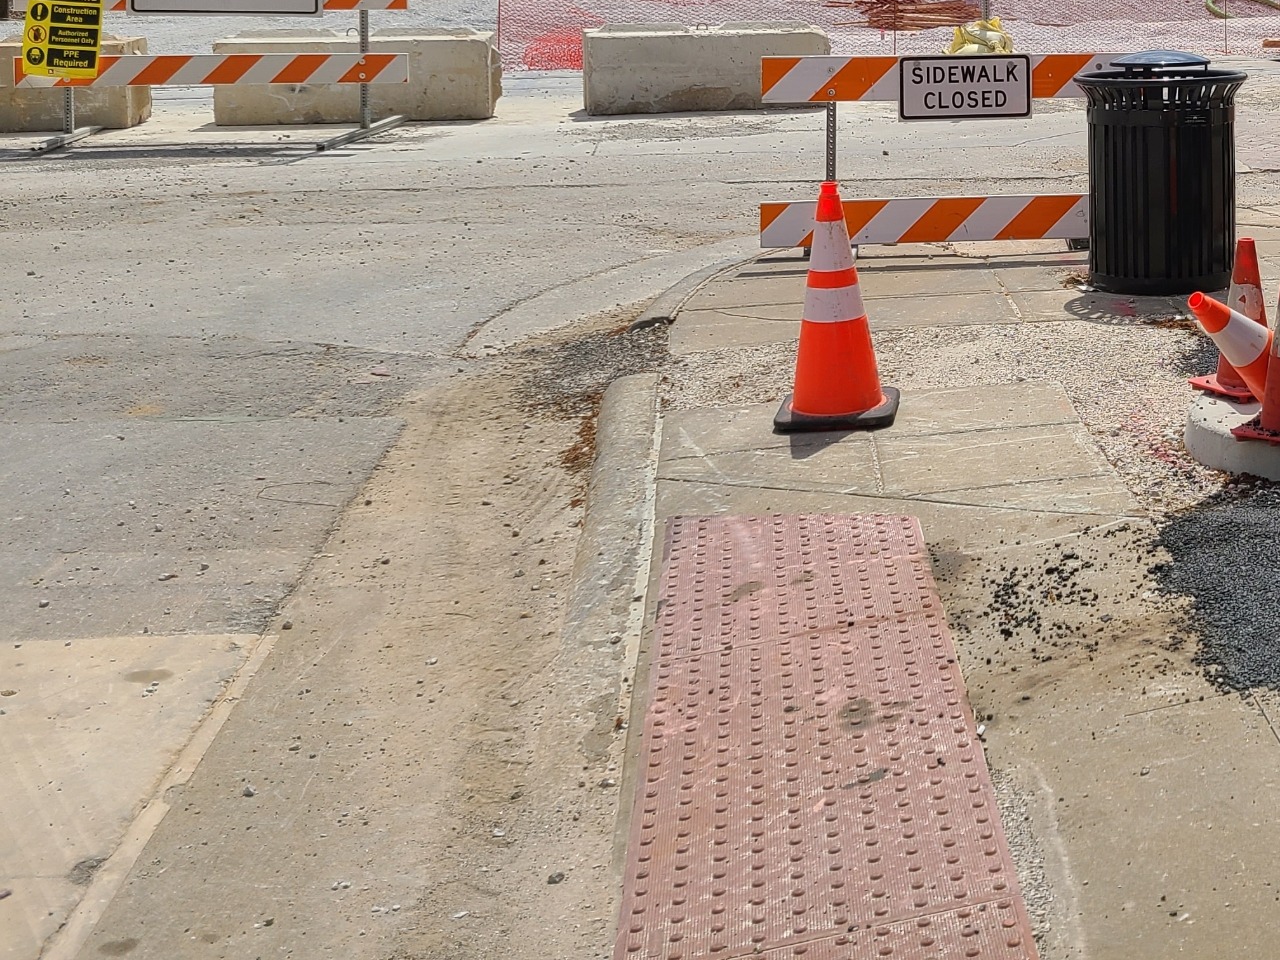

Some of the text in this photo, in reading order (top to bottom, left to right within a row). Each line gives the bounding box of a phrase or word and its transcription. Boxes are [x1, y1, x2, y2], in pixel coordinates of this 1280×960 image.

[53, 5, 97, 15] Construction
[65, 15, 83, 23] Area
[58, 29, 89, 37] Authorized
[81, 37, 95, 45] Only
[63, 50, 80, 58] PPE
[53, 58, 89, 68] Required
[911, 64, 1019, 85] SIDEWALK
[923, 89, 1007, 110] CLOSED
